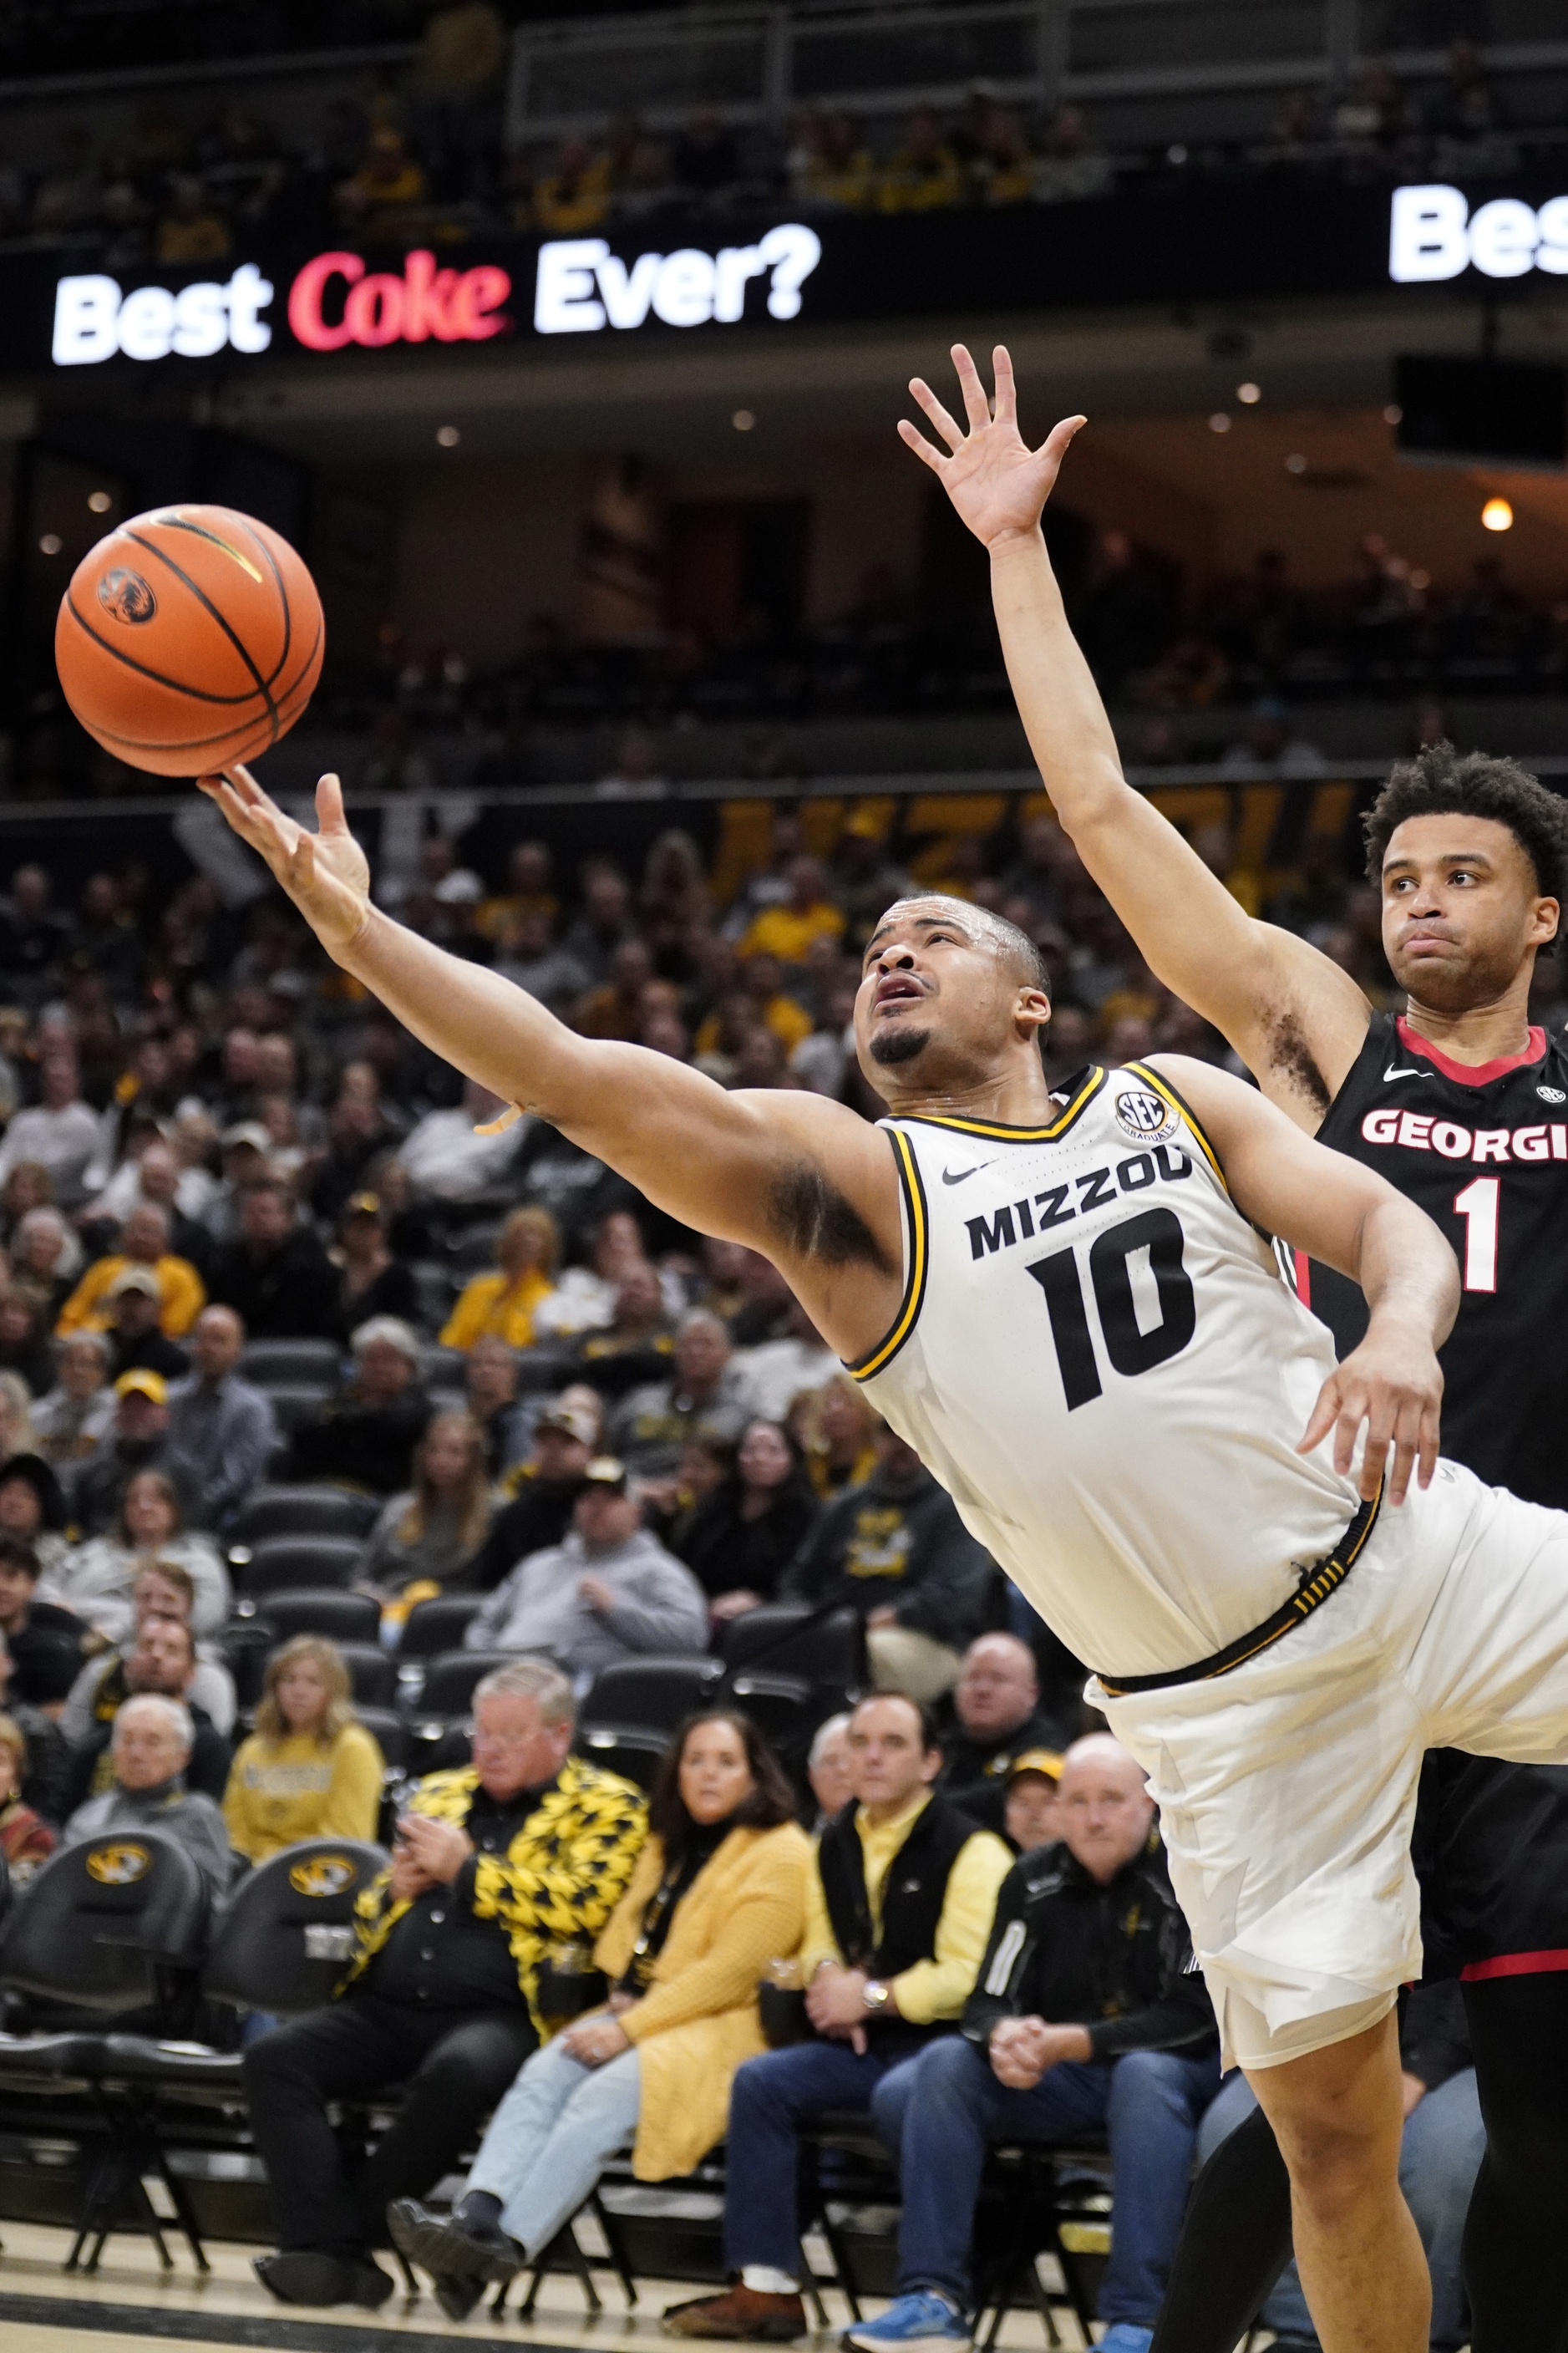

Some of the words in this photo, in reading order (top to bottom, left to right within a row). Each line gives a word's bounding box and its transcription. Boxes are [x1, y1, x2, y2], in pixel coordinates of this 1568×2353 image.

[52, 263, 273, 365] Best
[288, 249, 511, 351] Coke
[535, 223, 821, 333] Ever?
[1119, 1094, 1163, 1130] SEC
[1124, 1123, 1175, 1142] GRADUATE
[1361, 1109, 1568, 1162] GEORGI
[964, 1144, 1193, 1261] MIZZOU
[1454, 1176, 1500, 1293] 1
[1025, 1207, 1196, 1412] 10
